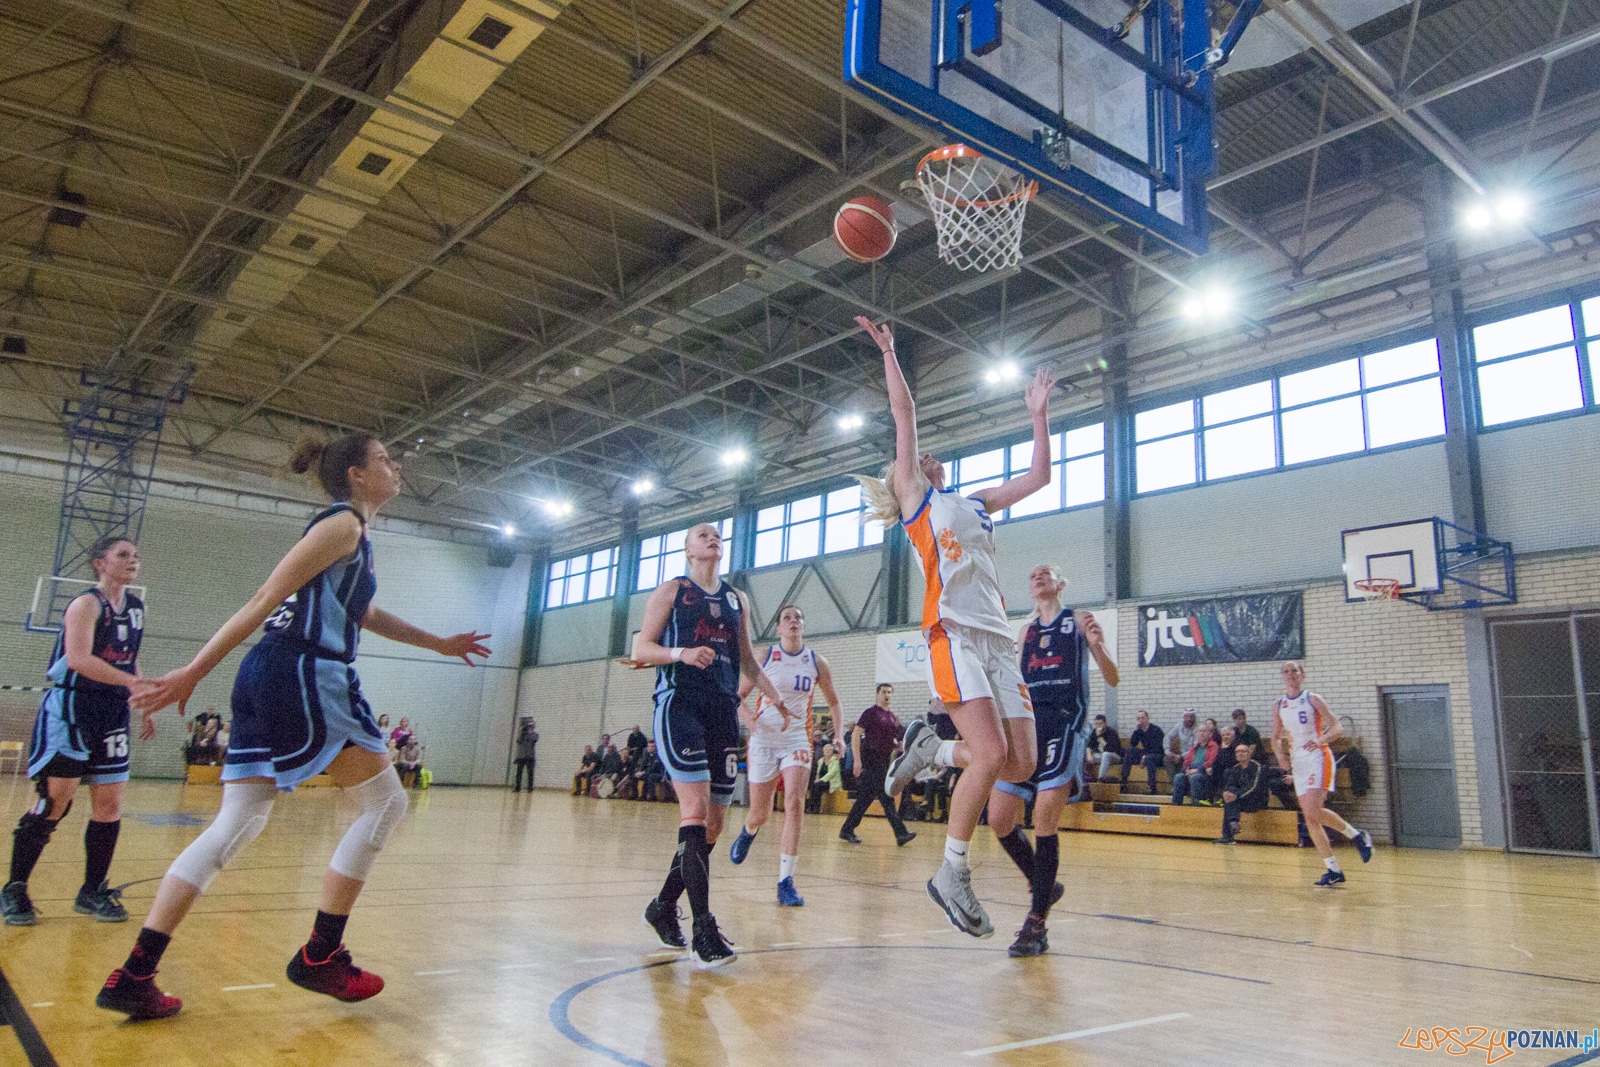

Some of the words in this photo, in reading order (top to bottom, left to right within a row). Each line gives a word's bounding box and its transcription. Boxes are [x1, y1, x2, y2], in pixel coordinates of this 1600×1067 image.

[1060, 616, 1074, 634] 5
[1143, 607, 1196, 666] jtc
[794, 674, 811, 692] 10
[1298, 710, 1308, 725] 6
[103, 733, 128, 758] 13
[1045, 743, 1056, 766] 5
[725, 753, 738, 778] 6
